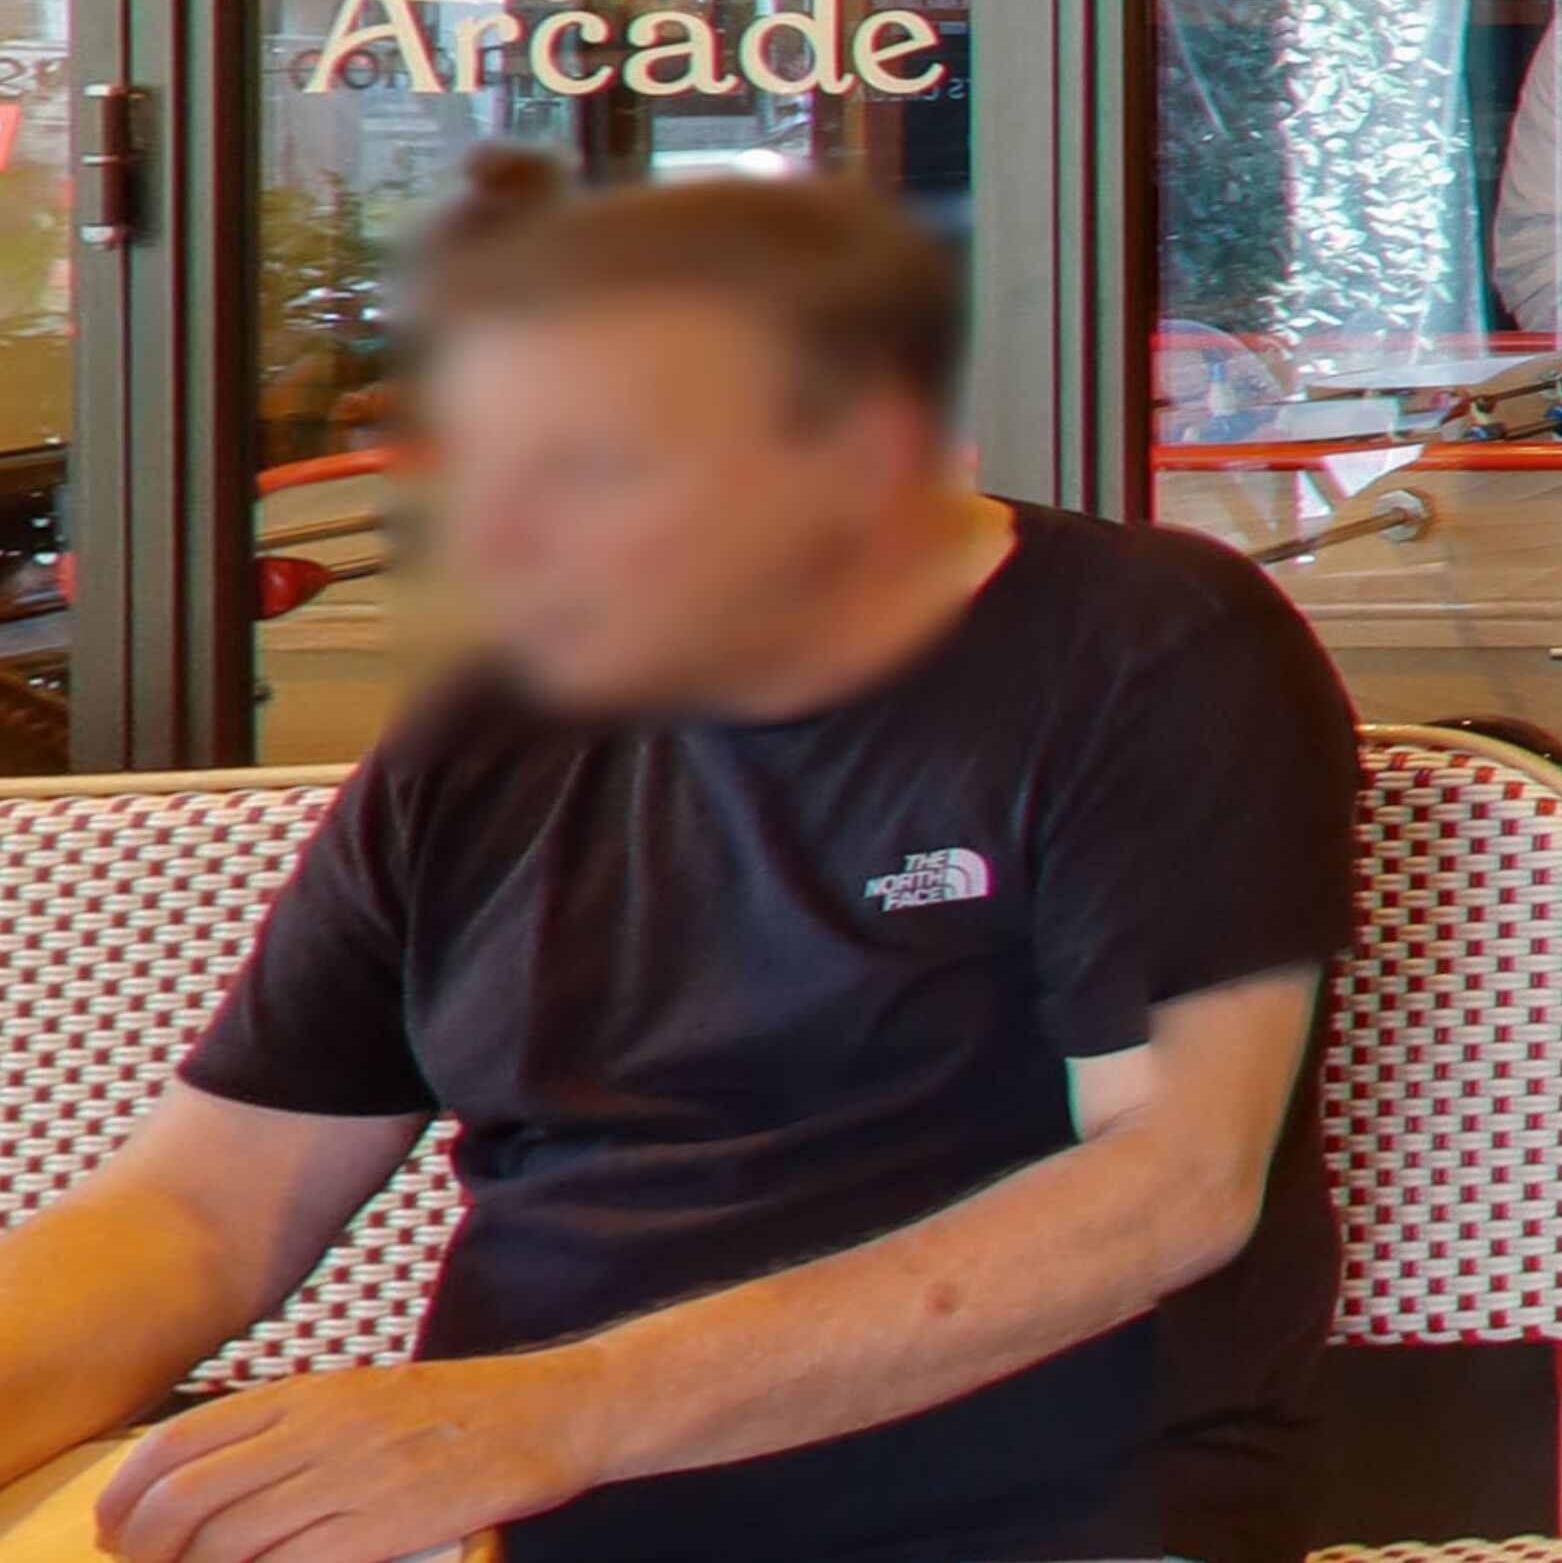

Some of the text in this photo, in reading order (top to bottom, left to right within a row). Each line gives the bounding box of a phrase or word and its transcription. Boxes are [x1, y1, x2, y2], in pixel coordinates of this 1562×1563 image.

[904, 849, 949, 872] THE
[864, 868, 944, 899] NORTH
[882, 888, 944, 913] FACE
